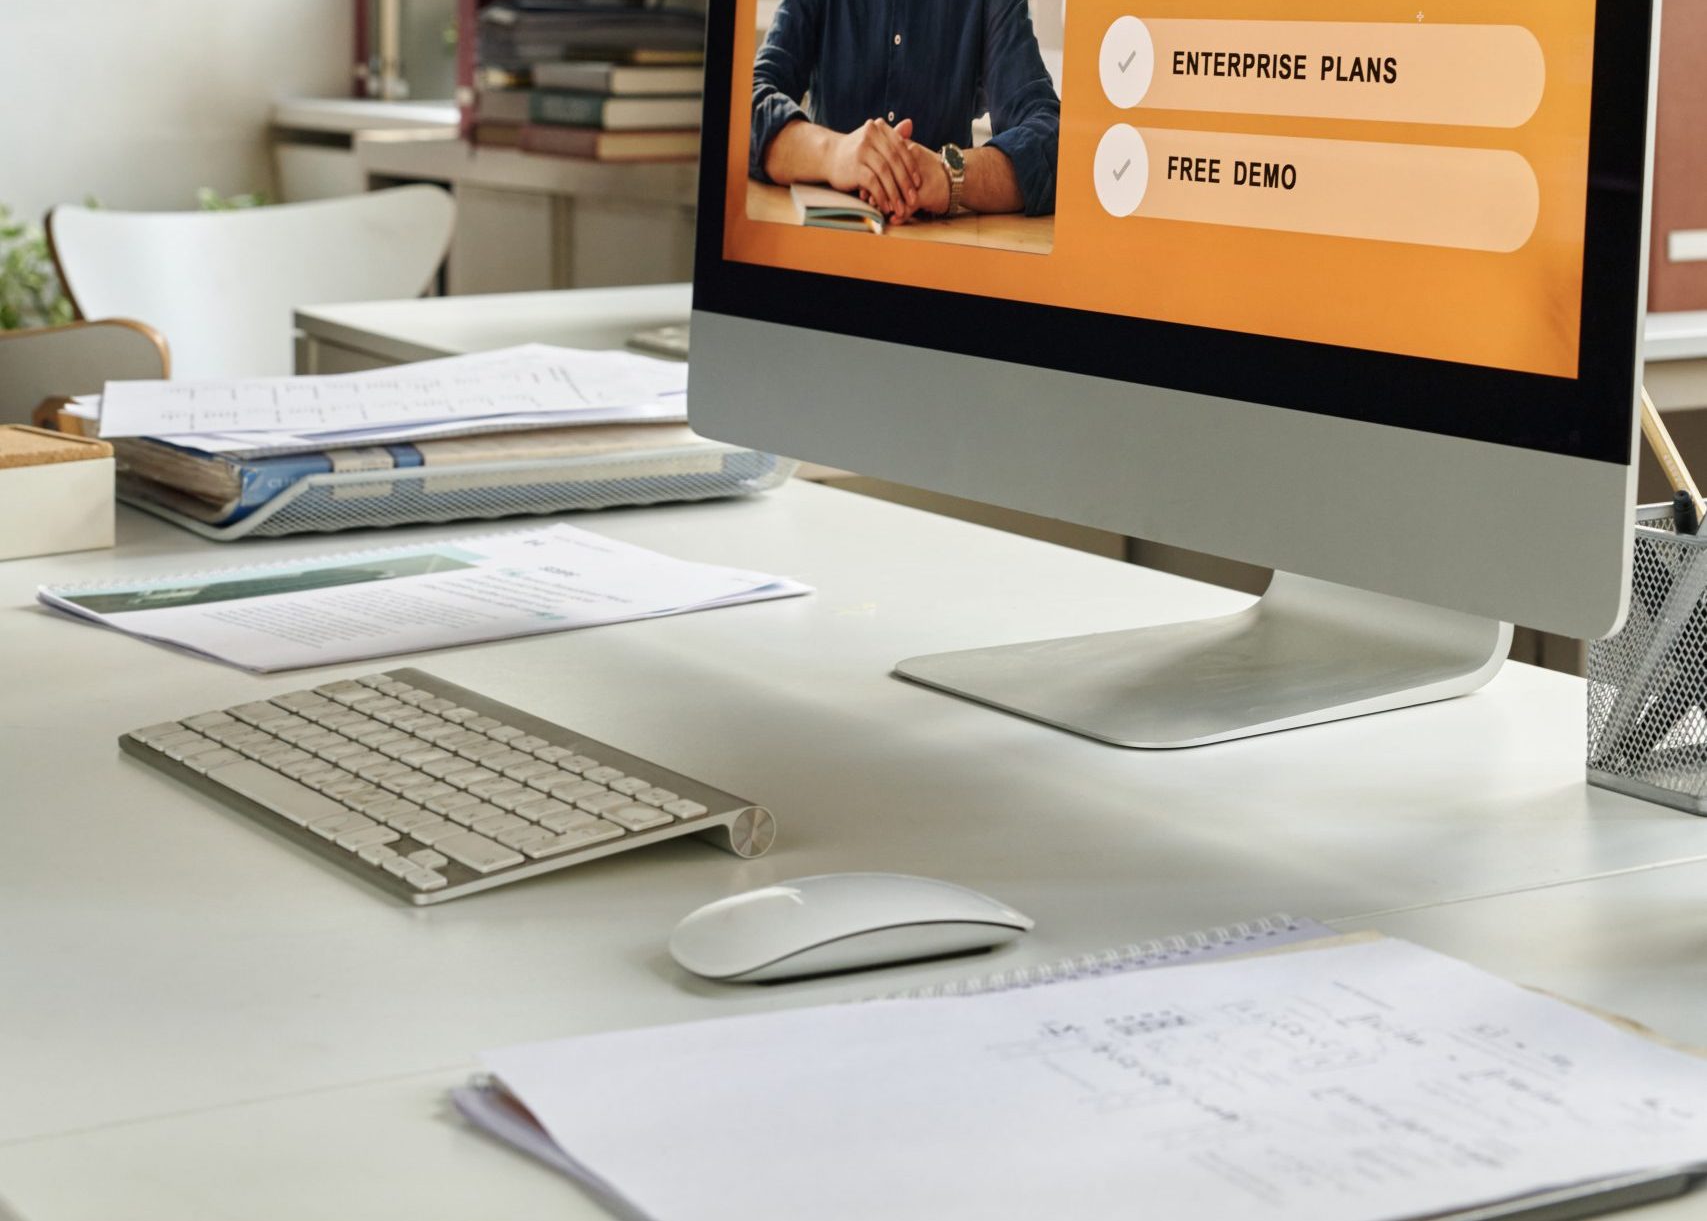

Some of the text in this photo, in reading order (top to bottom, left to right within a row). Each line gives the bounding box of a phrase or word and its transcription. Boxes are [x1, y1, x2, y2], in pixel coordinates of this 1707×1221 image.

[1172, 51, 1398, 84] ENTERPRISE PLANS
[1167, 156, 1297, 190] FREE DEMO
